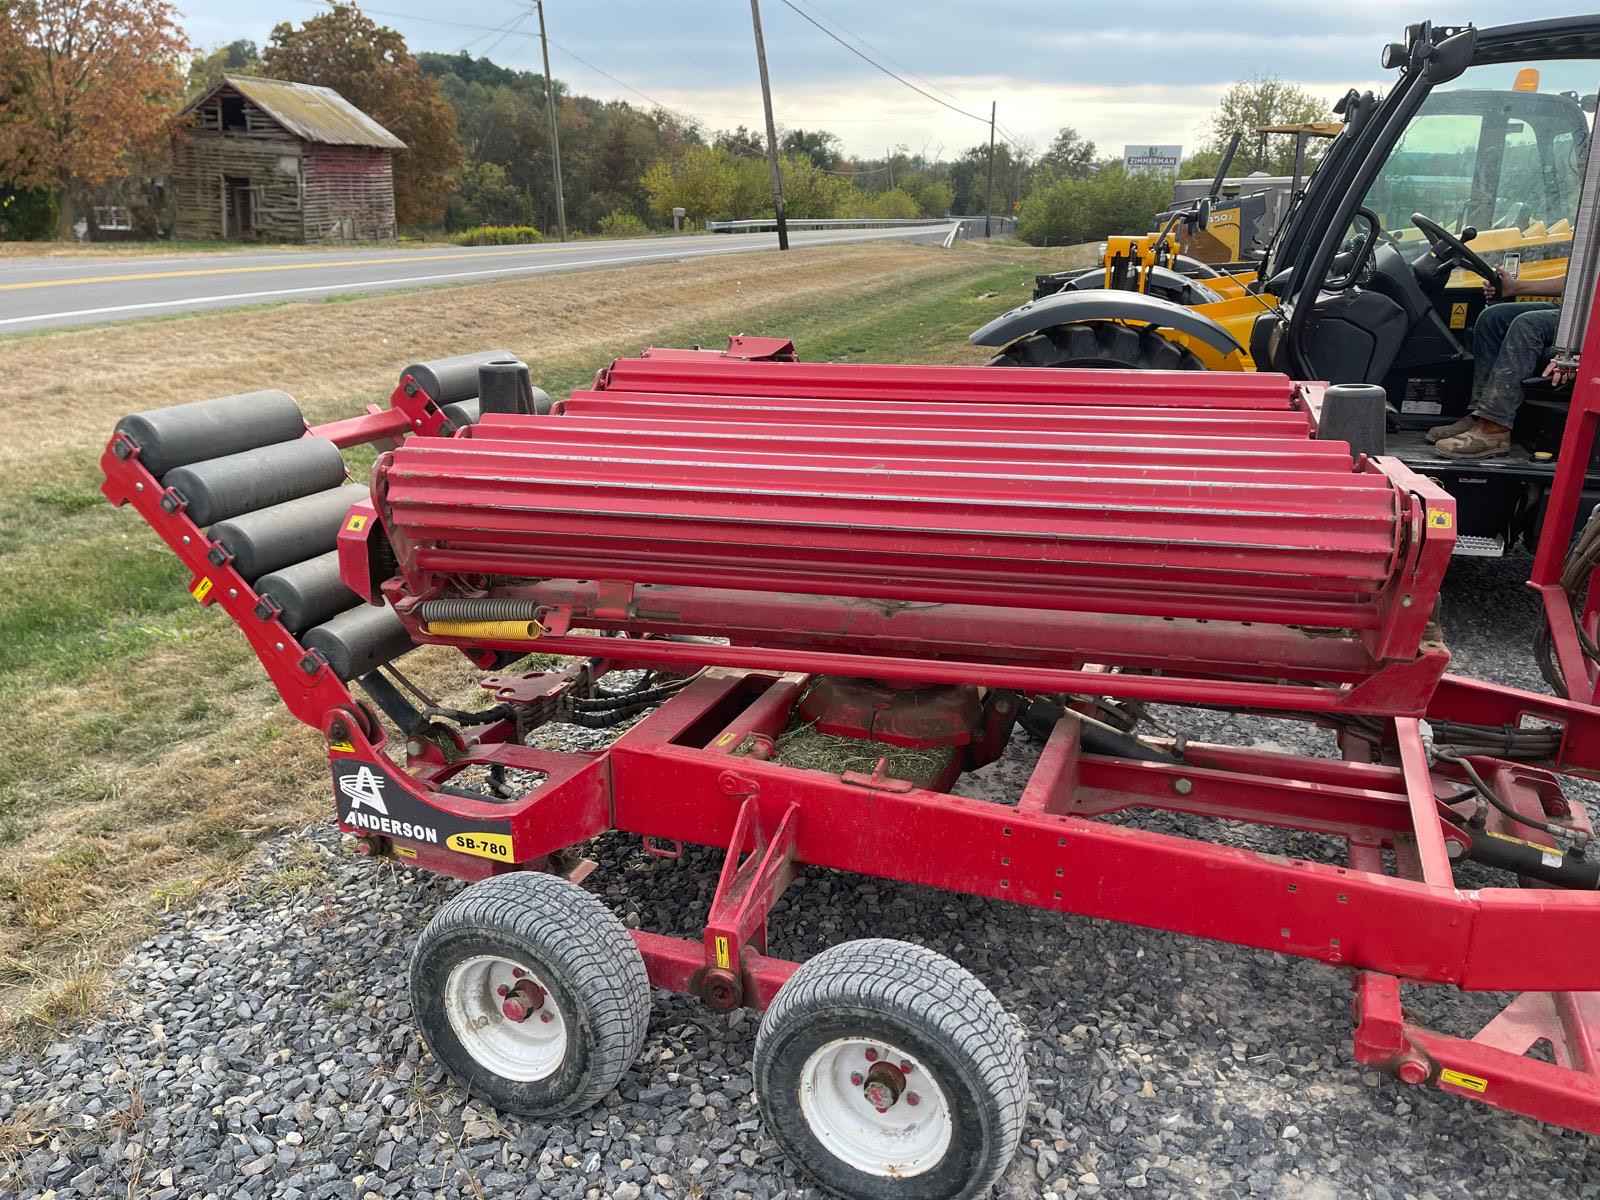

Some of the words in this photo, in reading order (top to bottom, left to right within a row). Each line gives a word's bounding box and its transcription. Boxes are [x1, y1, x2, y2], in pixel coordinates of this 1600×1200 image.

[1129, 157, 1175, 165] ZIMMERMAN
[344, 811, 437, 843] ANDERSON
[454, 835, 506, 856] SB-780
